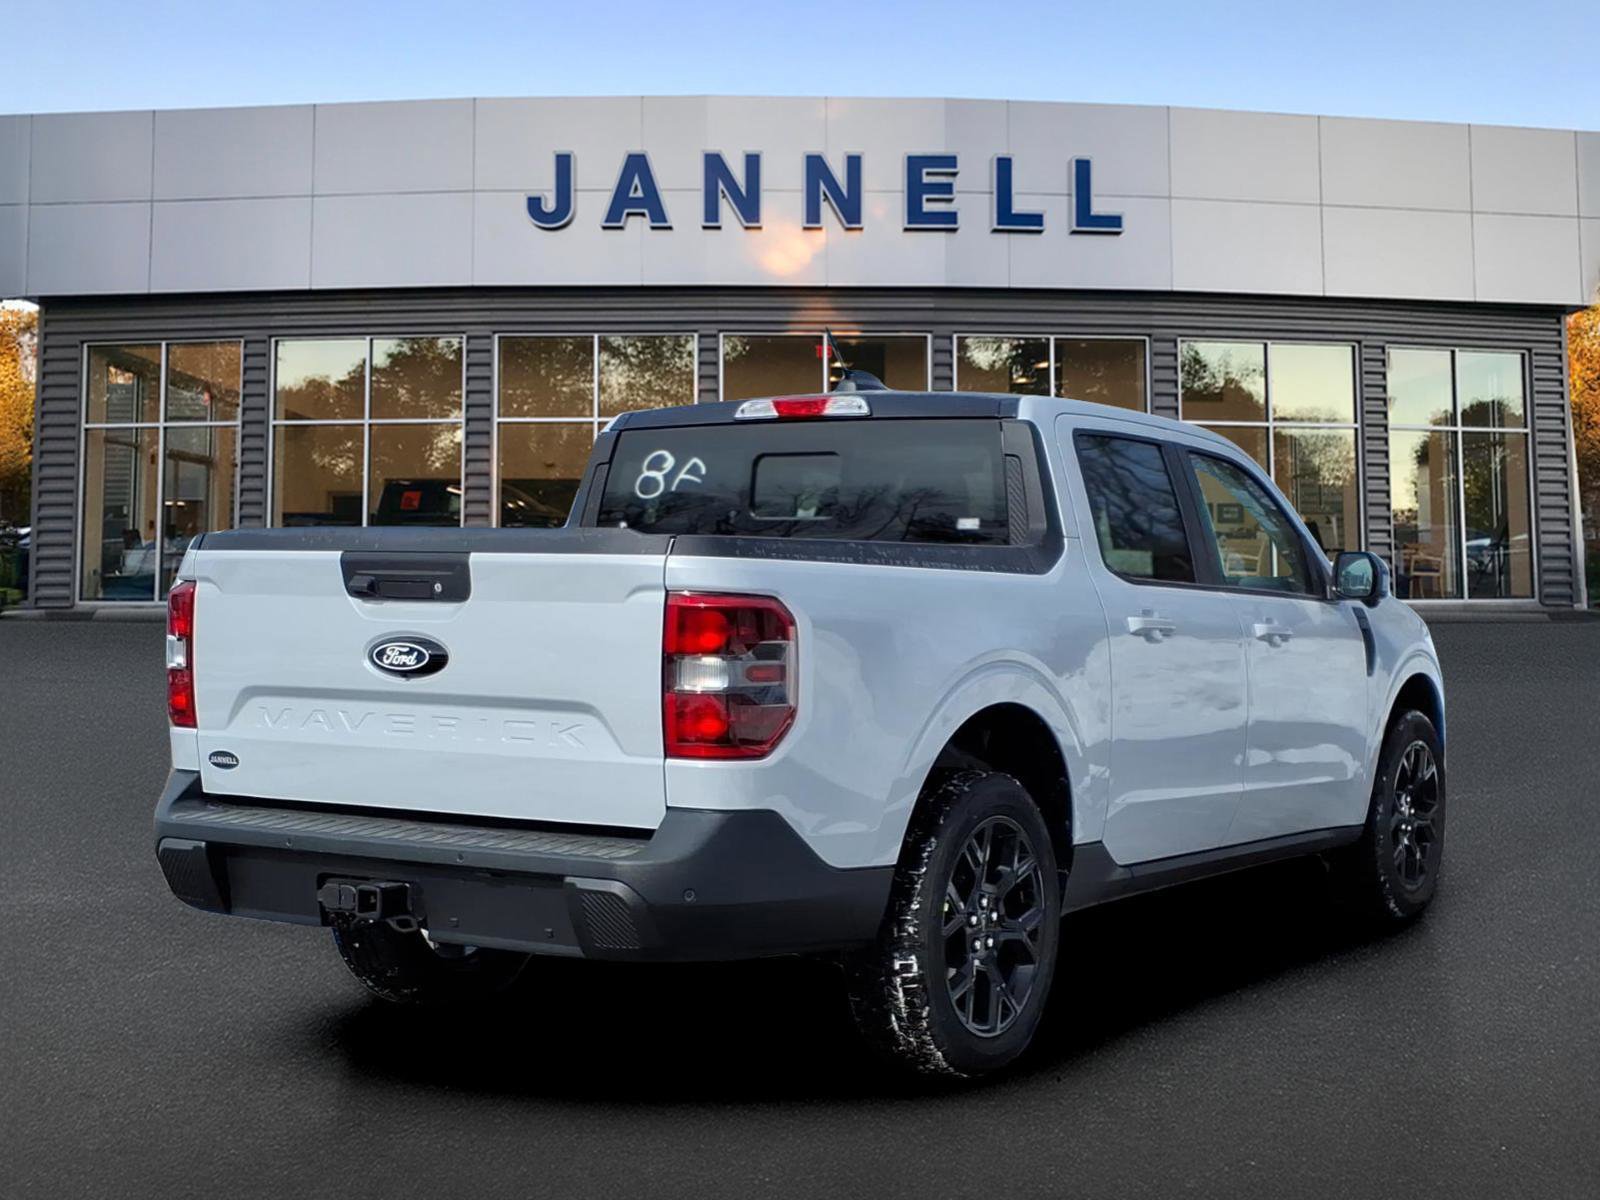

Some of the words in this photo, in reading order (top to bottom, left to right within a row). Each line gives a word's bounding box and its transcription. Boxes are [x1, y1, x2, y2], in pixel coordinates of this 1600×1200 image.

[525, 150, 1124, 235] JANNELL
[382, 646, 418, 666] Ford
[256, 705, 590, 750] MAVERICK
